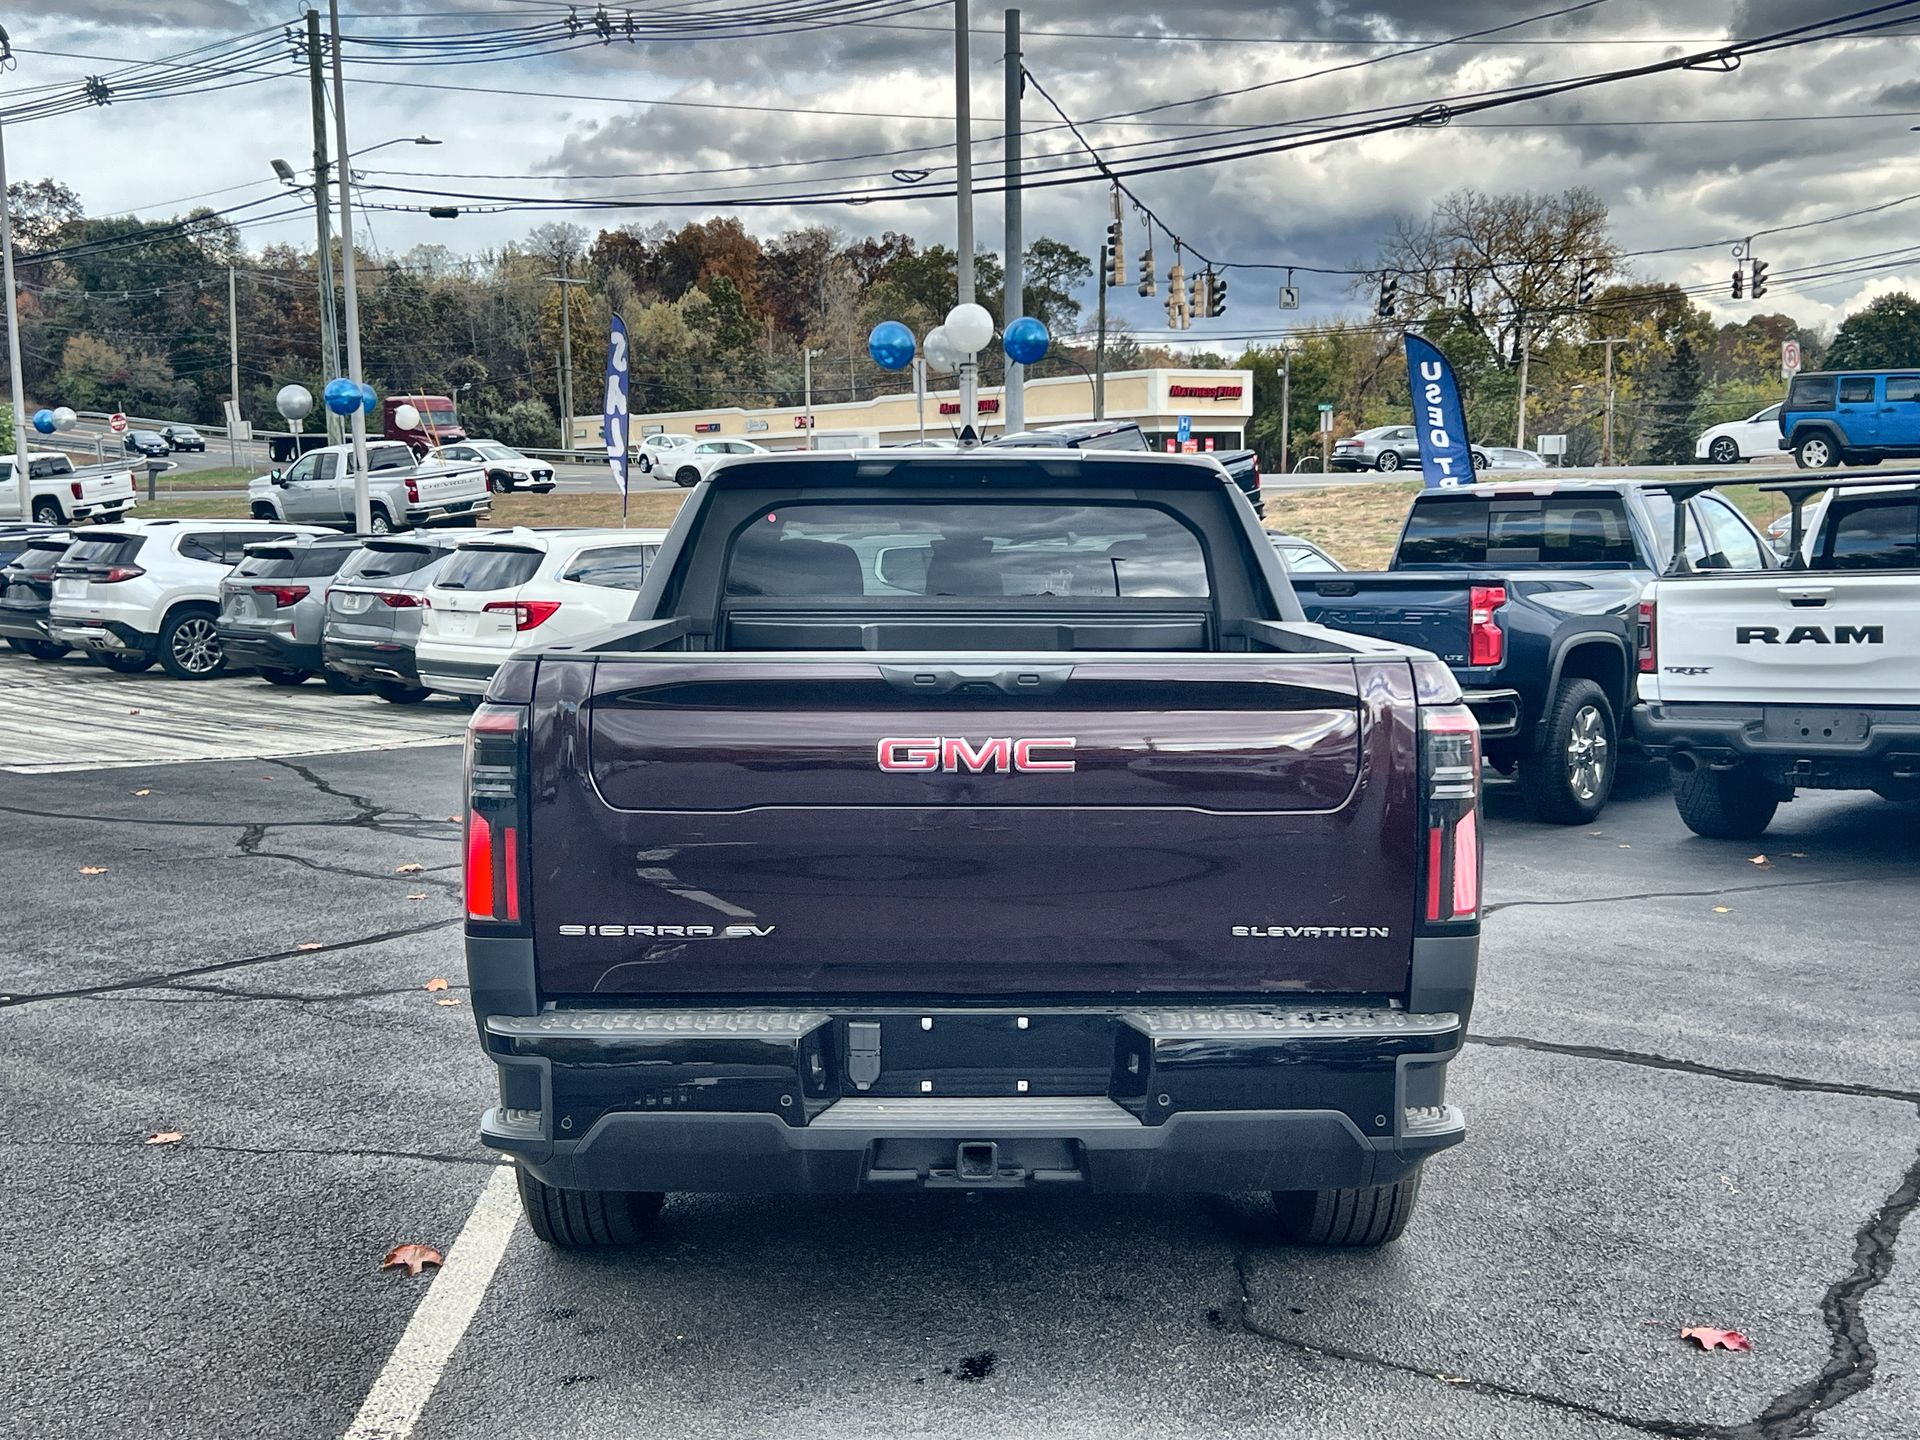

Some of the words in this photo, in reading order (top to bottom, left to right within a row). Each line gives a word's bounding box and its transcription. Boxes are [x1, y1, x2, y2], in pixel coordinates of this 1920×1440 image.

[1169, 385, 1216, 398] MATTRESS
[1216, 386, 1242, 398] FIRM
[940, 403, 961, 414] MATT
[1181, 418, 1189, 430] H
[422, 477, 480, 490] CHEVROLET
[1314, 610, 1450, 625] ROLET
[1736, 625, 1884, 644] RAM
[1664, 666, 1714, 676] TRX
[877, 736, 1077, 774] GMC
[558, 924, 714, 937] SIERRA
[724, 924, 776, 937] EV
[1231, 925, 1390, 939] ELEVATION
